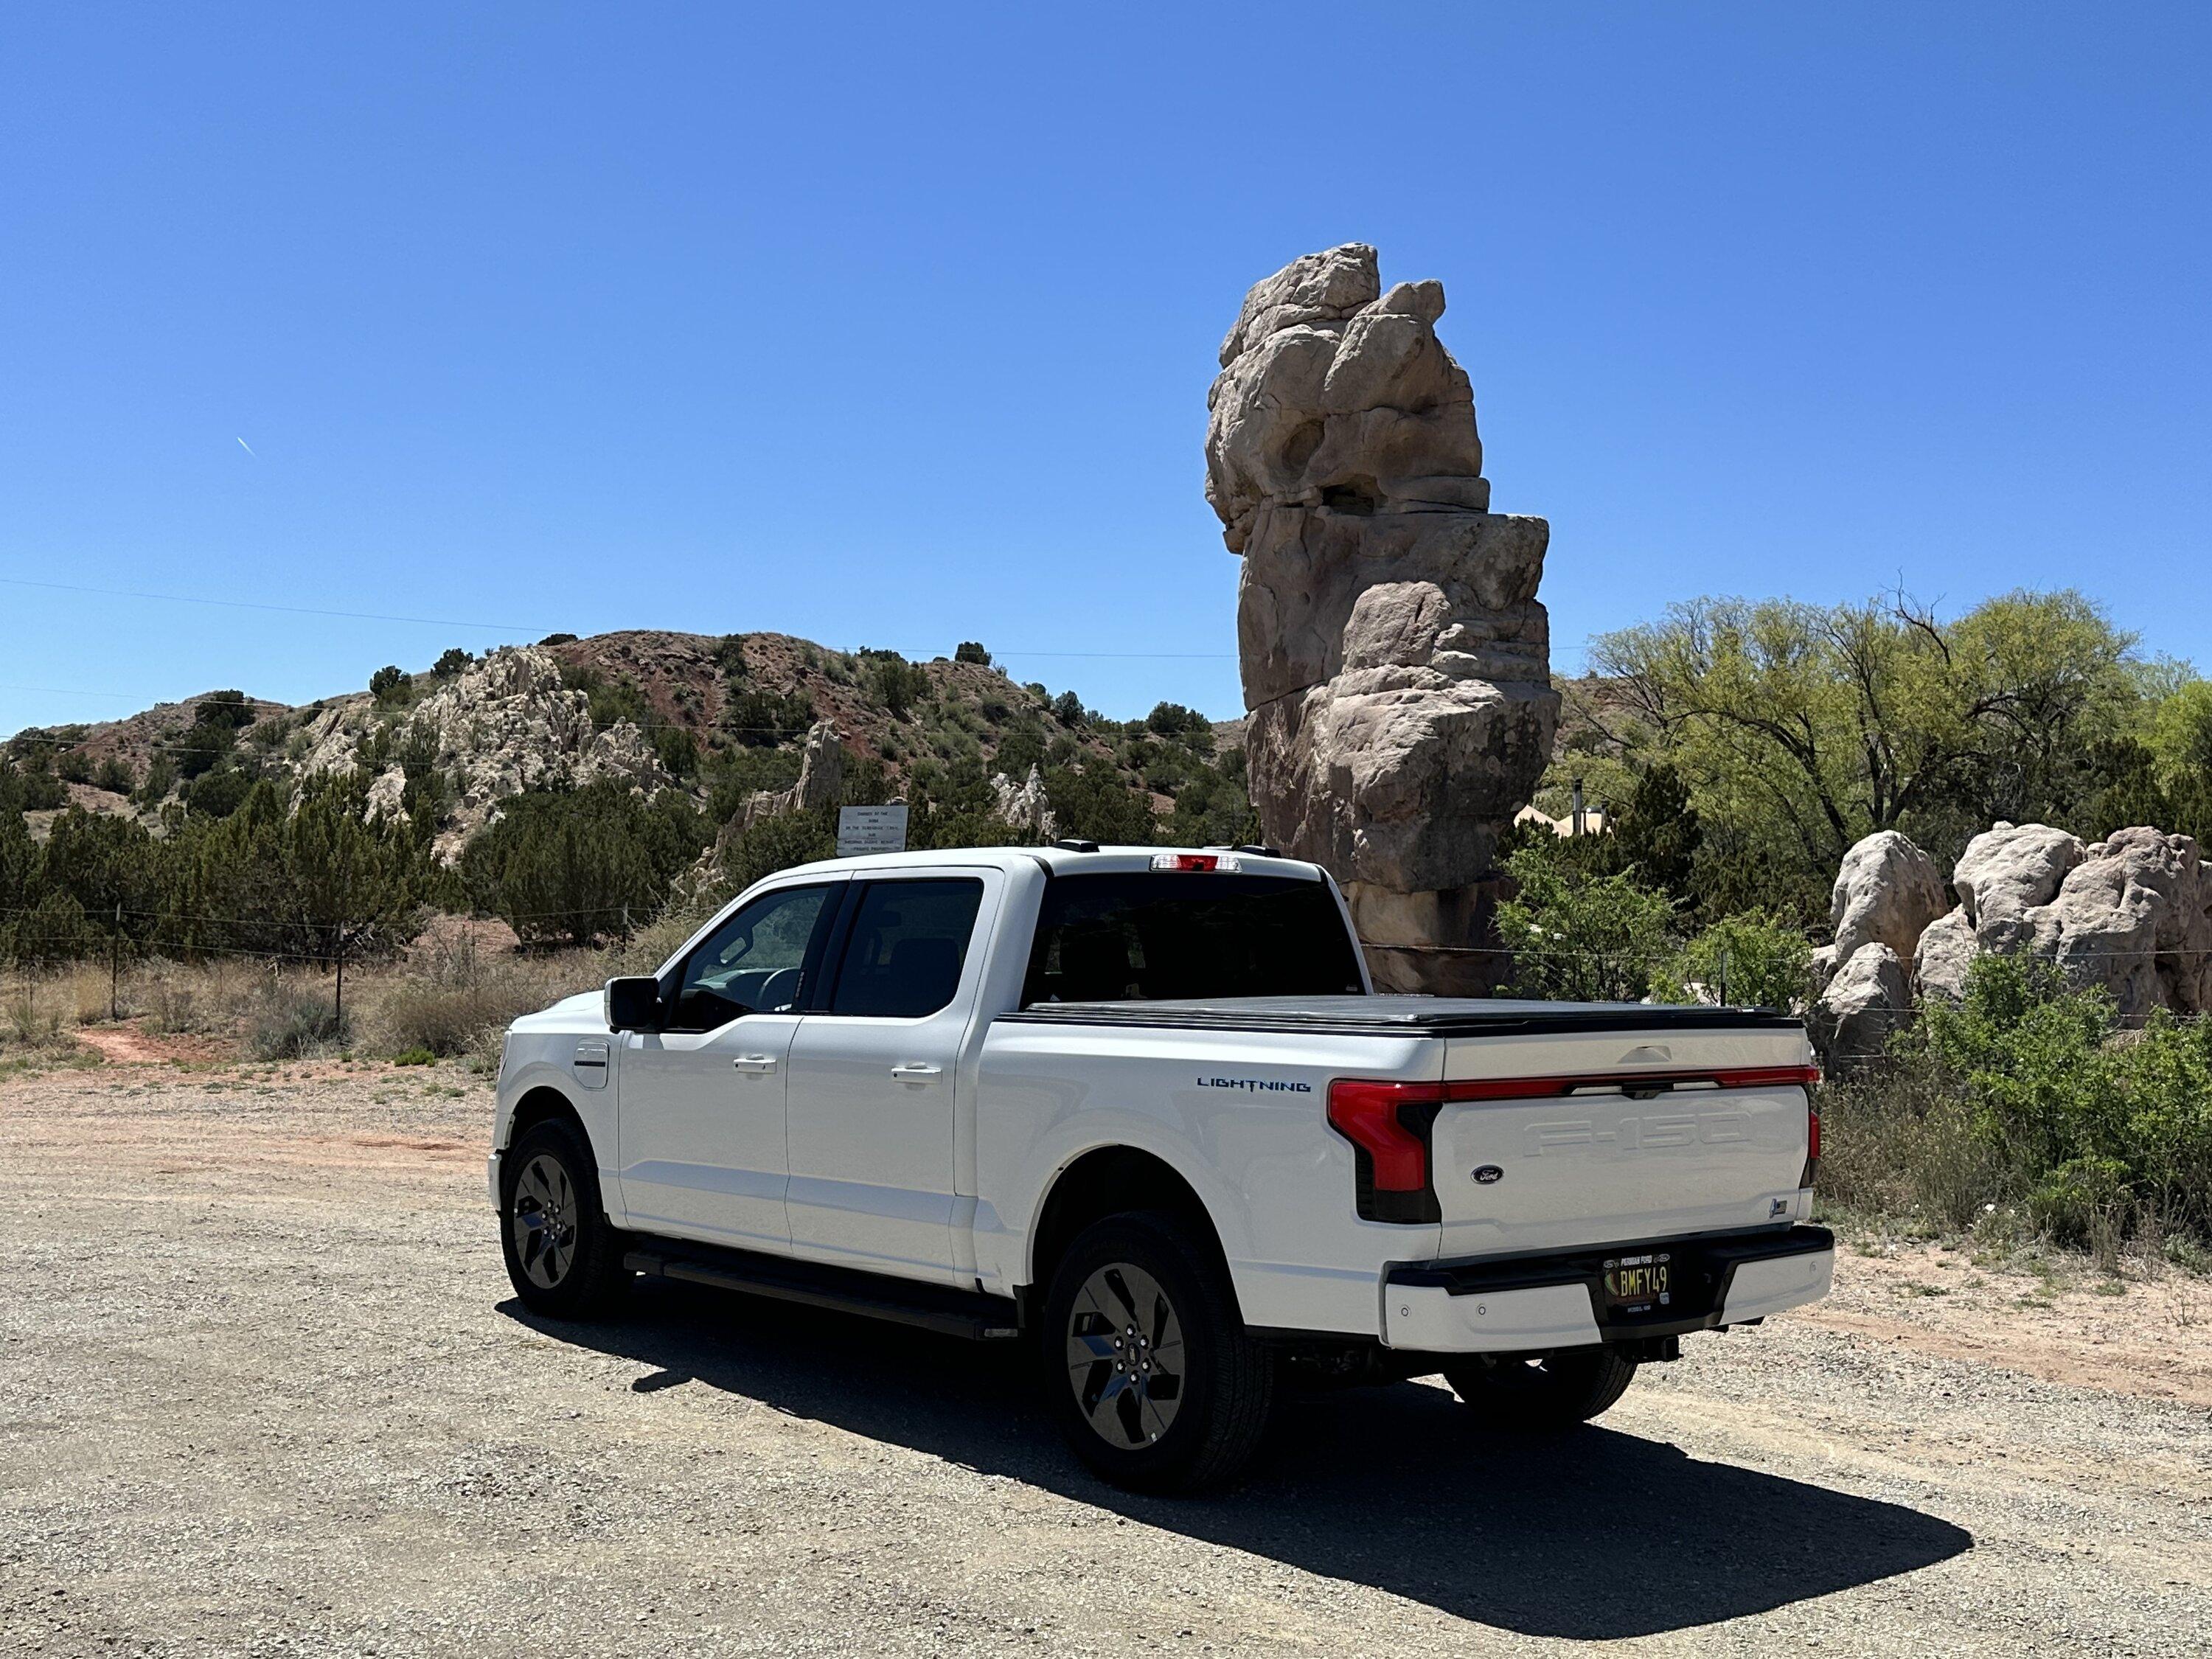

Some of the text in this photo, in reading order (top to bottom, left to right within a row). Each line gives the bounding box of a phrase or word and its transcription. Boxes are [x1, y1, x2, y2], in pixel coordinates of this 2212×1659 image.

[1197, 1077, 1312, 1093] LIGHTNING
[1523, 1111, 1752, 1158] F-150
[1620, 1266, 1667, 1297] BMFY49
